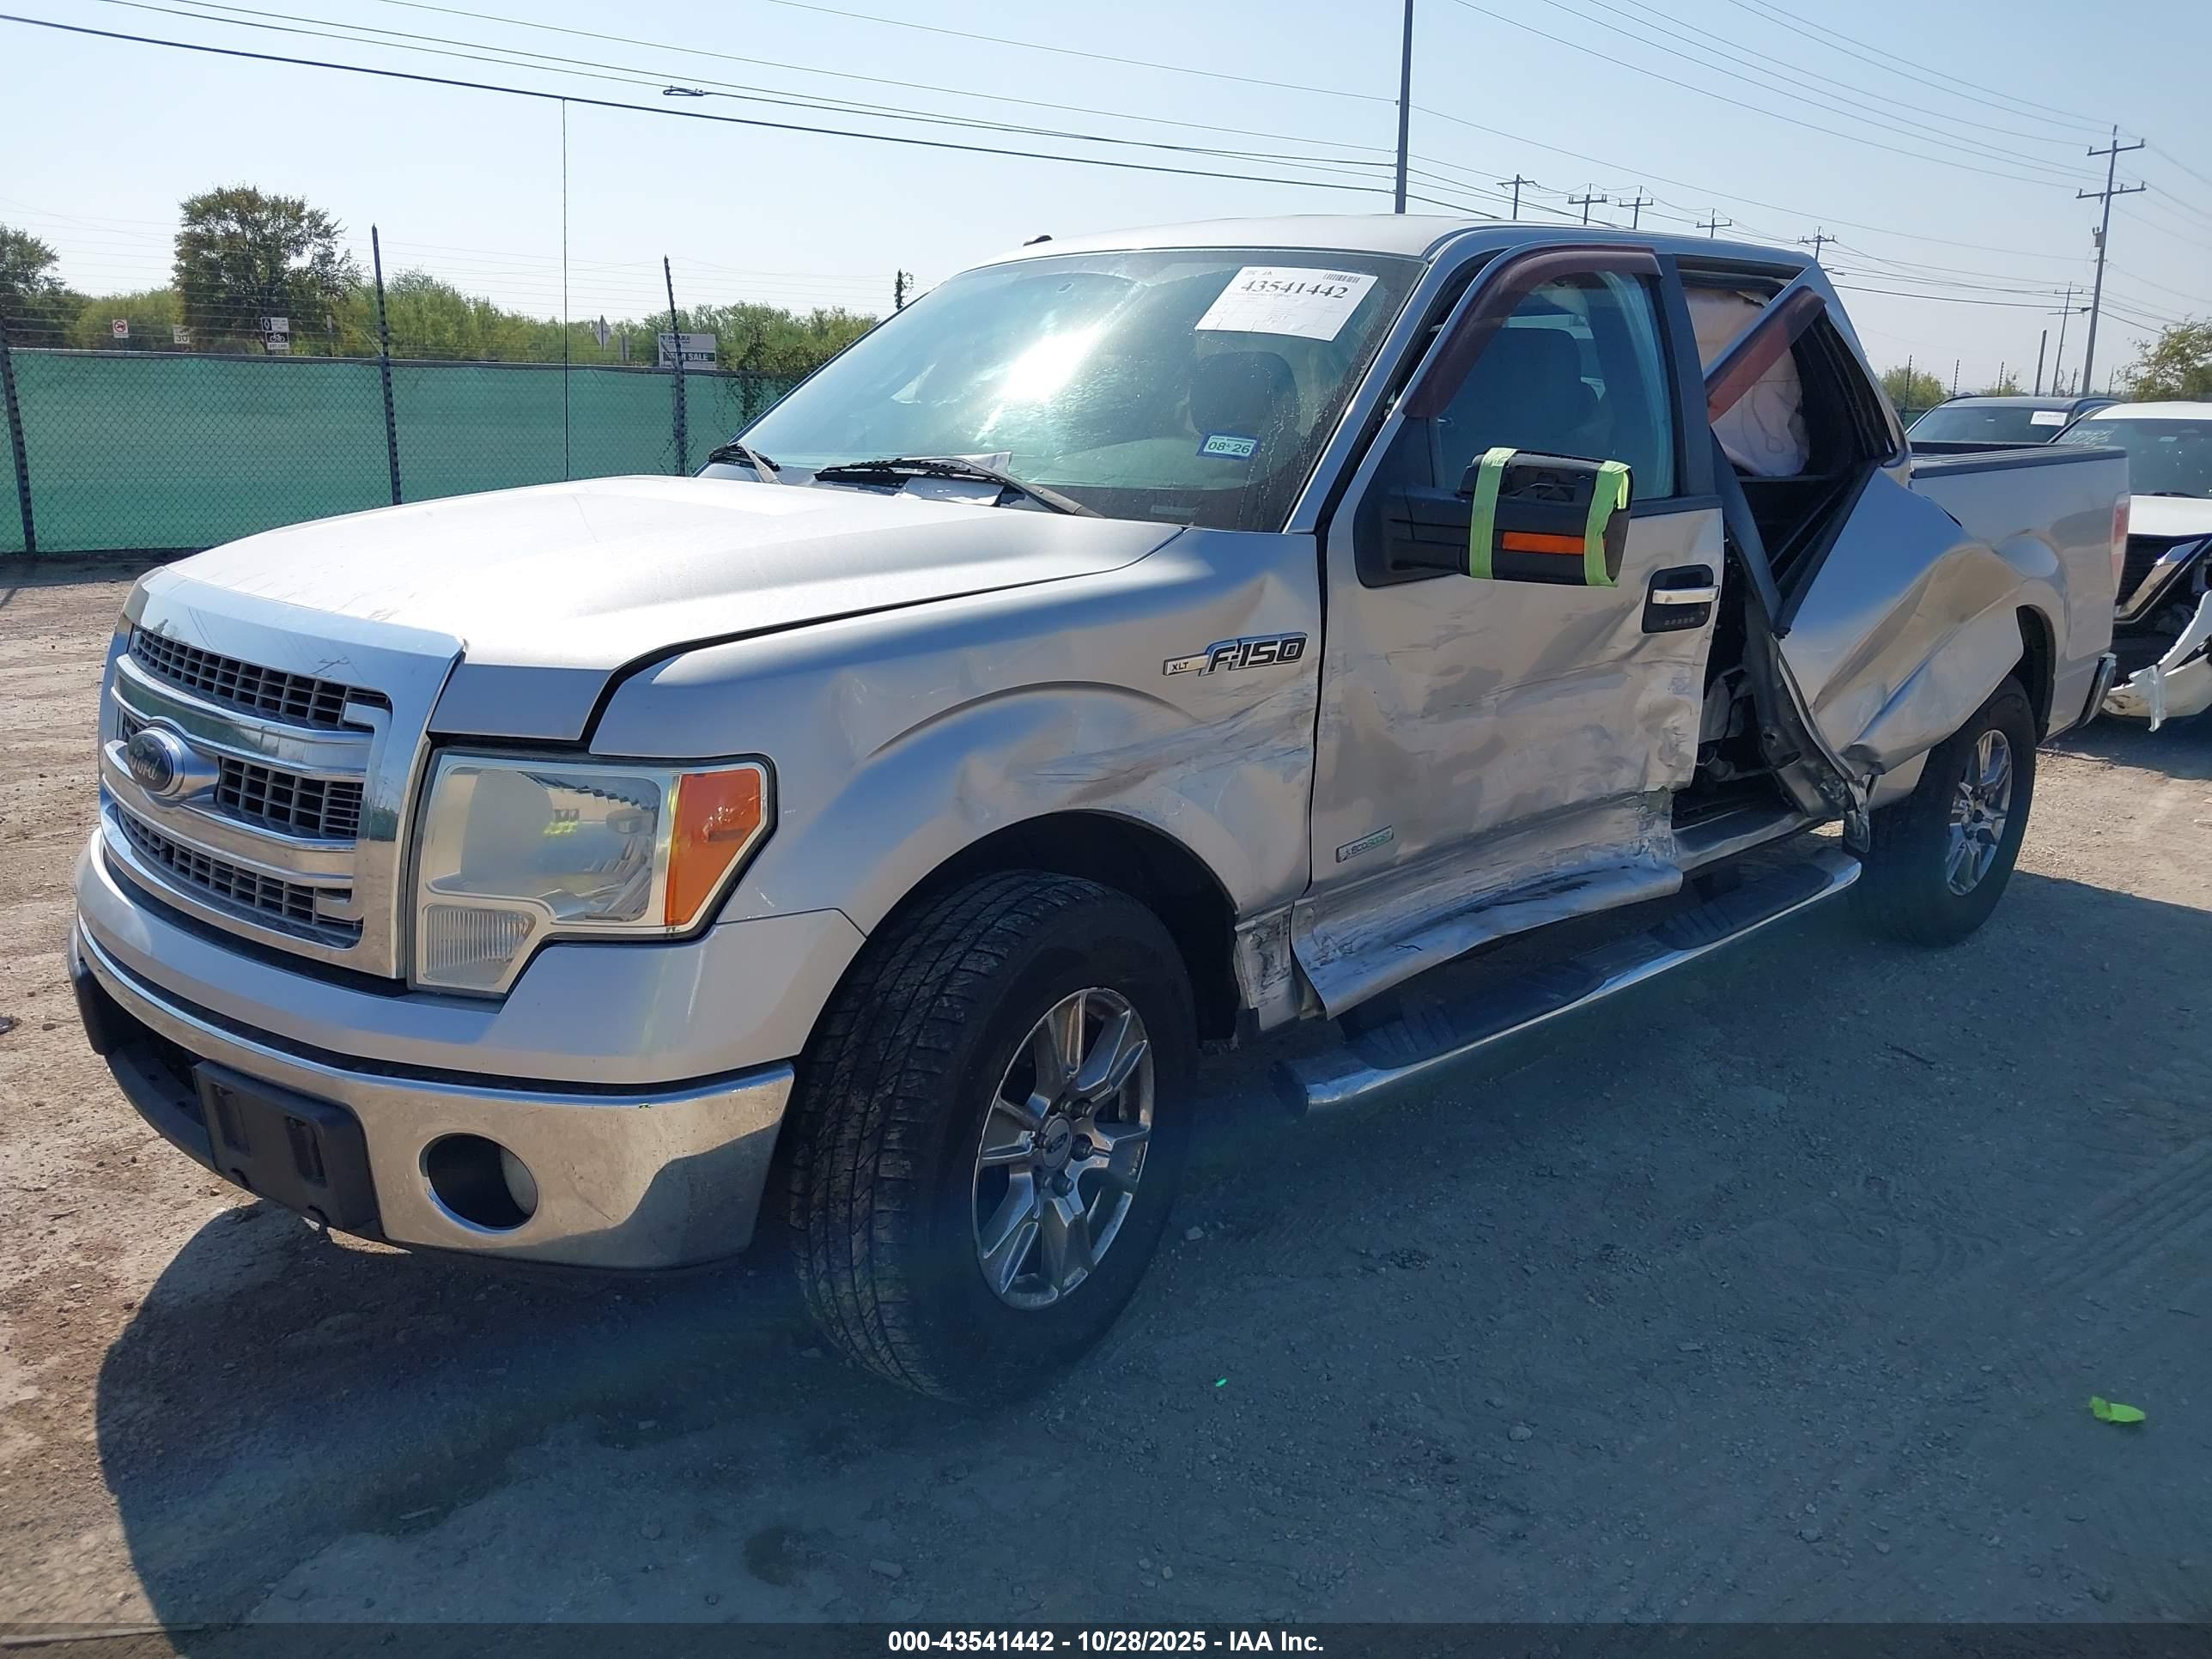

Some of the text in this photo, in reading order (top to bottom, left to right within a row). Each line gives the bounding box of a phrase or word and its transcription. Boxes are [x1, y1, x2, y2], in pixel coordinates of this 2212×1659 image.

[1241, 280, 1349, 299] 43541442
[1231, 443, 1251, 453] 26
[1207, 637, 1307, 672] F-150
[1171, 661, 1189, 672] XLT
